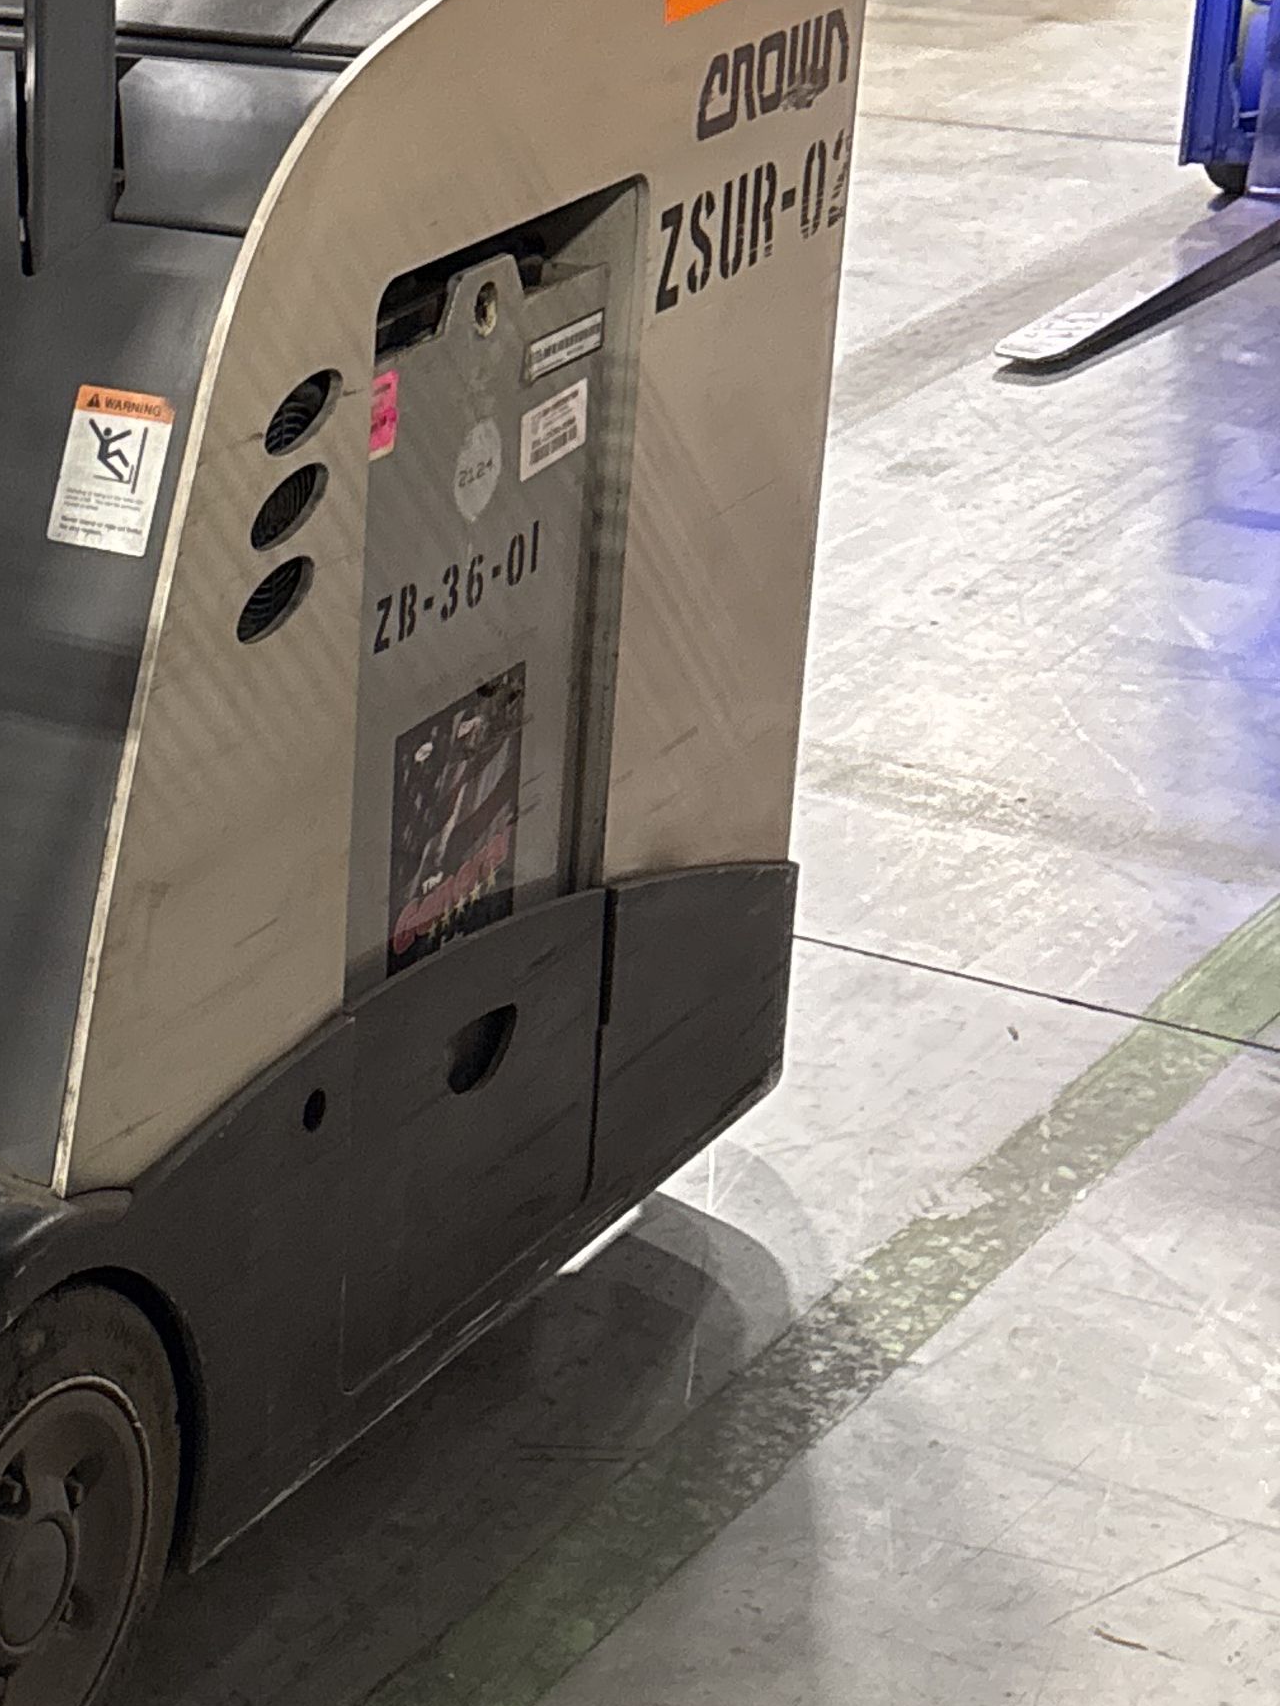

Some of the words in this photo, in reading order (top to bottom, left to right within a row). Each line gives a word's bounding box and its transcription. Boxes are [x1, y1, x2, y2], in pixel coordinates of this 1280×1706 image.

[697, 8, 849, 141] CROWN
[105, 396, 162, 417] WARNING
[373, 520, 540, 655] ZB-36-01
